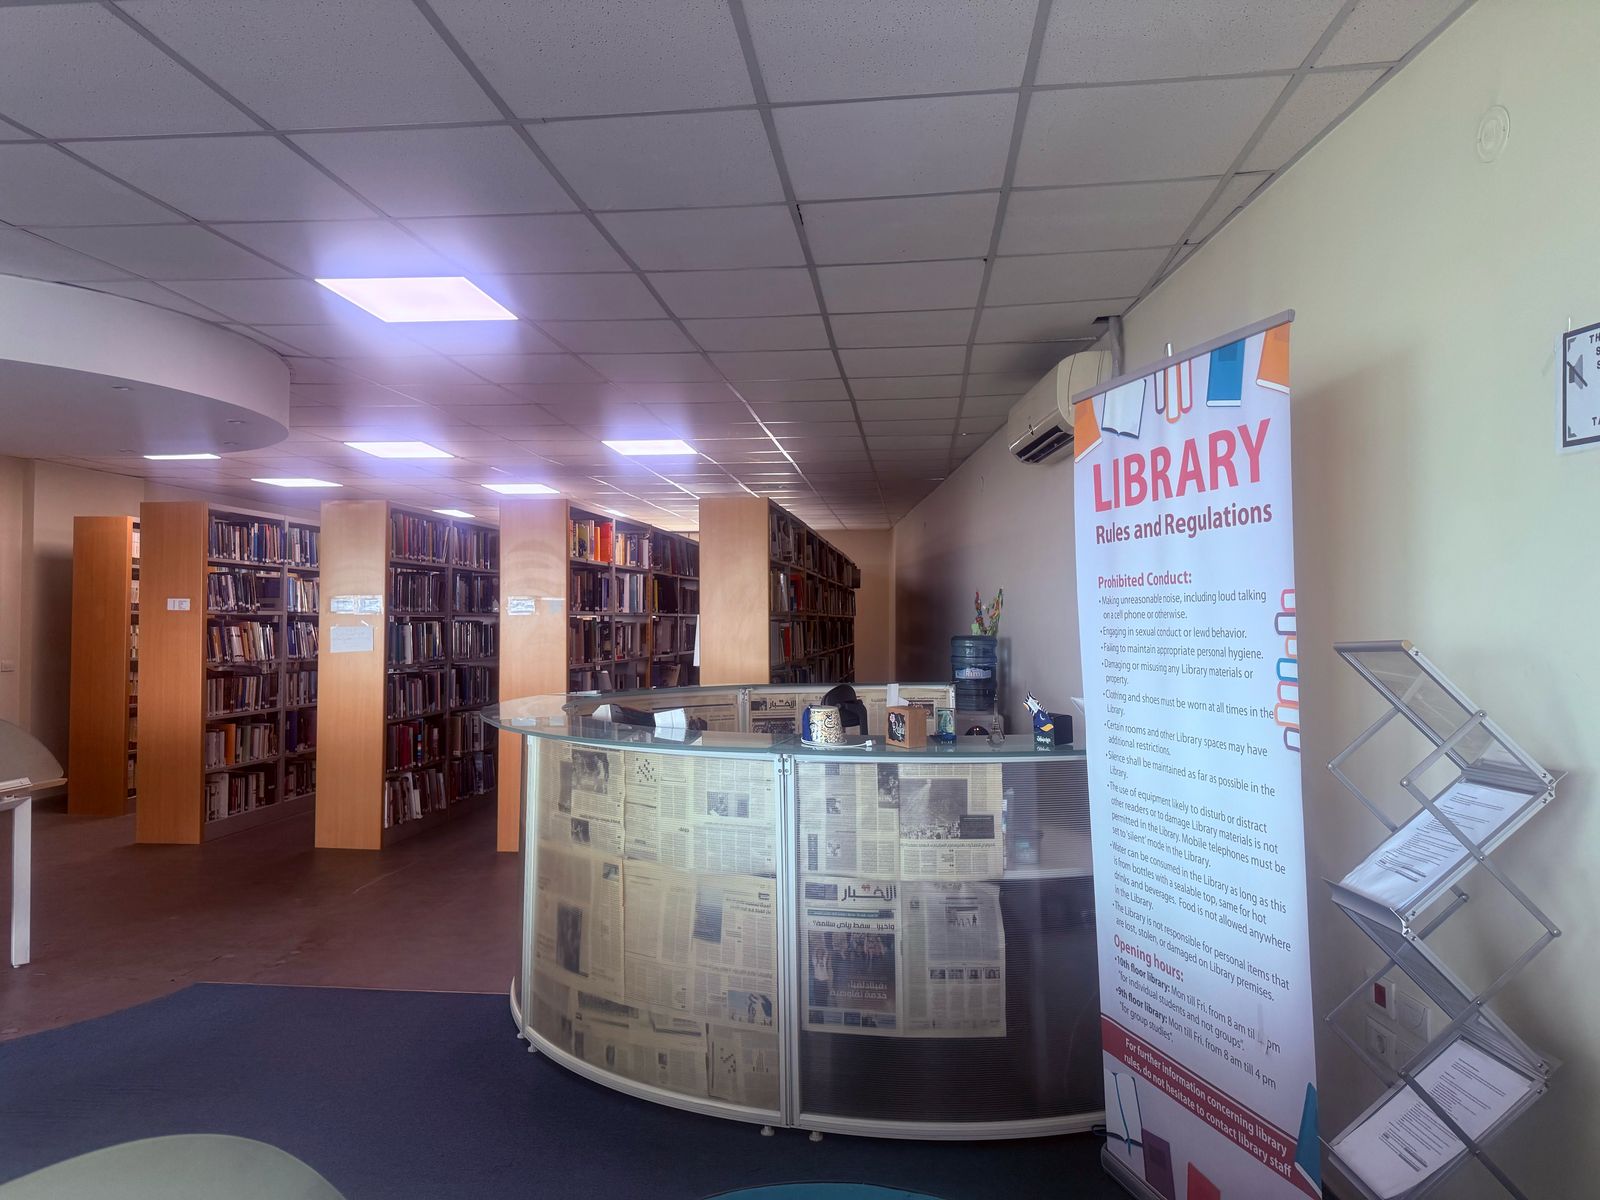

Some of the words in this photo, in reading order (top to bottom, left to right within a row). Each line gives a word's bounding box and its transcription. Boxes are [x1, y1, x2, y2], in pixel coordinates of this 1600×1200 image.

[1093, 418, 1270, 512] LIBRARY
[1096, 522, 1130, 544] Rules
[1134, 515, 1162, 539] and
[1164, 503, 1272, 538] Regulations
[1098, 572, 1144, 588] Prohibited
[1146, 570, 1192, 585] Conduct:
[1120, 593, 1162, 604] unreasonable
[1162, 593, 1182, 604] noise,
[1183, 591, 1217, 604] including
[1218, 590, 1236, 601] loud
[1238, 589, 1266, 602] talking
[1154, 608, 1188, 618] otherwise.
[1156, 627, 1182, 637] conduct
[1193, 626, 1210, 637] lewd
[1211, 627, 1247, 638] behavior.
[1140, 661, 1167, 675] misusing
[1168, 665, 1179, 675] any
[1181, 663, 1207, 677] Library
[1208, 666, 1242, 678] materials
[1244, 670, 1253, 678] or
[1156, 645, 1195, 656] appropriate
[1196, 646, 1226, 658] personal
[1228, 647, 1264, 660] hygiene.
[1160, 698, 1175, 707] must
[1176, 697, 1186, 708] be
[1186, 701, 1207, 710] worn
[1208, 703, 1215, 712] at
[1216, 702, 1224, 712] all
[1225, 703, 1248, 716] times
[1249, 705, 1258, 716] in
[1260, 706, 1274, 719] the
[1159, 730, 1175, 740] other
[1176, 732, 1202, 747] Library
[1203, 738, 1227, 750] spaces
[1228, 742, 1245, 755] may
[1246, 743, 1268, 756] have
[1152, 762, 1186, 776] maintained
[1188, 770, 1196, 779] as
[1197, 769, 1207, 780] far
[1208, 774, 1217, 783] as
[1218, 776, 1248, 791] possible
[1250, 781, 1258, 793] in
[1260, 783, 1275, 796] the
[1137, 791, 1171, 806] equipment
[1171, 798, 1189, 814] likely
[1190, 804, 1198, 814] to
[1200, 806, 1226, 821] disturb
[1226, 815, 1234, 824] or
[1236, 816, 1267, 833] distract
[1164, 811, 1190, 829] damage
[1191, 819, 1217, 838] Library
[1218, 829, 1252, 846] materials
[1254, 837, 1261, 849] is
[1263, 842, 1278, 854] not
[1158, 825, 1181, 843] Library.
[1181, 833, 1207, 849] Mobile
[1208, 842, 1249, 863] telephones
[1250, 856, 1273, 870] must
[1274, 860, 1286, 874] be
[1165, 842, 1171, 853] in
[1172, 845, 1183, 858] the
[1183, 849, 1211, 868] Library.
[1150, 856, 1180, 874] consumed
[1181, 866, 1188, 878] in
[1189, 870, 1202, 882] the
[1203, 874, 1229, 894] Library
[1230, 886, 1238, 896] as
[1239, 887, 1257, 906] long
[1259, 896, 1268, 907] as
[1270, 898, 1286, 913] this
[1169, 879, 1173, 887] a
[1174, 882, 1202, 898] sealable
[1202, 891, 1217, 905] top,
[1219, 898, 1238, 913] same
[1239, 903, 1250, 917] for
[1252, 908, 1266, 924] hot
[1178, 896, 1196, 912] Food
[1197, 904, 1203, 915] is
[1204, 909, 1217, 921] not
[1218, 914, 1248, 934] allowed
[1249, 928, 1291, 951] anywhere
[1114, 934, 1151, 967] Opening
[1153, 953, 1184, 981] hours:
[1164, 926, 1201, 949] responsible
[1202, 940, 1213, 954] for
[1214, 949, 1245, 969] personal
[1247, 961, 1270, 981] items
[1271, 973, 1290, 990] that
[1166, 940, 1197, 963] damaged
[1198, 958, 1208, 968] on
[1209, 960, 1234, 983] Library
[1236, 976, 1274, 1000] premises.
[1116, 955, 1130, 970] 10th
[1130, 962, 1146, 978] floor
[1146, 970, 1170, 992] library:
[1170, 984, 1186, 1001] Mon
[1186, 994, 1196, 1006] till
[1196, 998, 1207, 1013] Fri.
[1208, 1004, 1226, 1023] from
[1227, 1015, 1232, 1026] 8
[1233, 1021, 1246, 1034] am
[1266, 1039, 1281, 1053] pm
[1128, 976, 1158, 999] individual
[1158, 995, 1186, 1016] students
[1186, 1011, 1200, 1024] and
[1201, 1019, 1214, 1033] not
[1117, 986, 1128, 999] 9th
[1128, 992, 1143, 1008] floor
[1144, 1001, 1167, 1023] library:
[1168, 1015, 1183, 1032] Mon
[1183, 1026, 1192, 1038] till
[1193, 1030, 1204, 1046] Fri.
[1205, 1037, 1222, 1056] from
[1223, 1049, 1229, 1060] 8
[1230, 1055, 1242, 1068] am
[1243, 1062, 1253, 1075] till
[1255, 1069, 1261, 1079] 4
[1262, 1074, 1276, 1088] pm
[1124, 1054, 1141, 1072] rules,
[1142, 1065, 1152, 1078] do
[1152, 1074, 1165, 1088] not
[1165, 1080, 1195, 1109] hesitate
[1195, 1103, 1204, 1116] to
[1206, 1112, 1237, 1139] contact
[1238, 1130, 1268, 1162] library
[1269, 1156, 1292, 1177] staff
[1125, 1037, 1137, 1052] For
[1137, 1045, 1162, 1069] further
[1162, 1062, 1206, 1100] information
[1207, 1096, 1254, 1135] concerning
[1255, 1124, 1287, 1156] library
